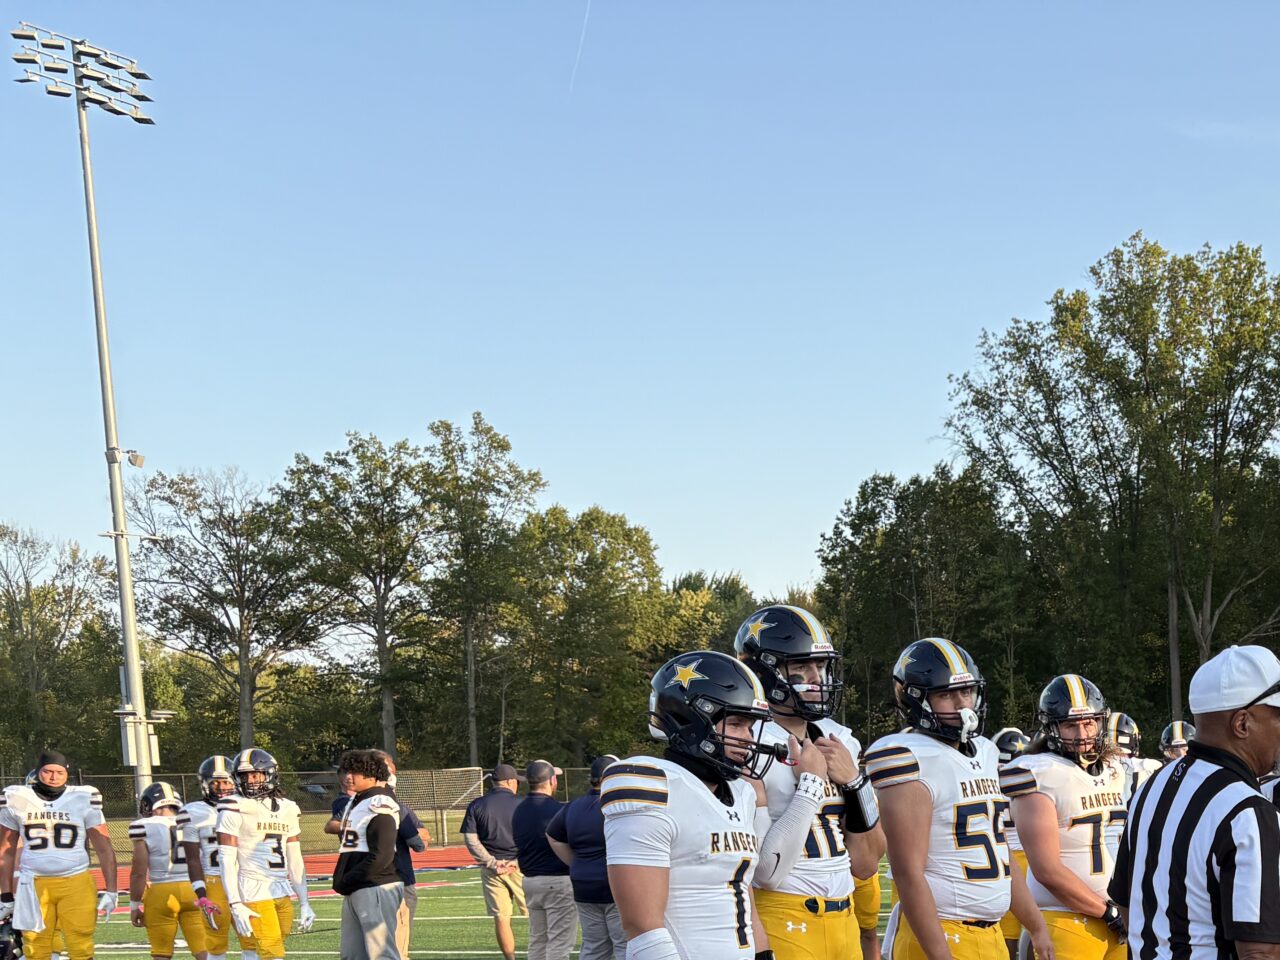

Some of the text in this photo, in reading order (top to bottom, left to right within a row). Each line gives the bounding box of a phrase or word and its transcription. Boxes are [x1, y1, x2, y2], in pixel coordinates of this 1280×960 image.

[1080, 792, 1123, 810] RANGERS
[27, 812, 71, 821] RANGERS
[256, 822, 289, 832] RANGERS
[24, 822, 78, 850] 50
[263, 833, 285, 869] 3
[727, 857, 752, 950] 1
